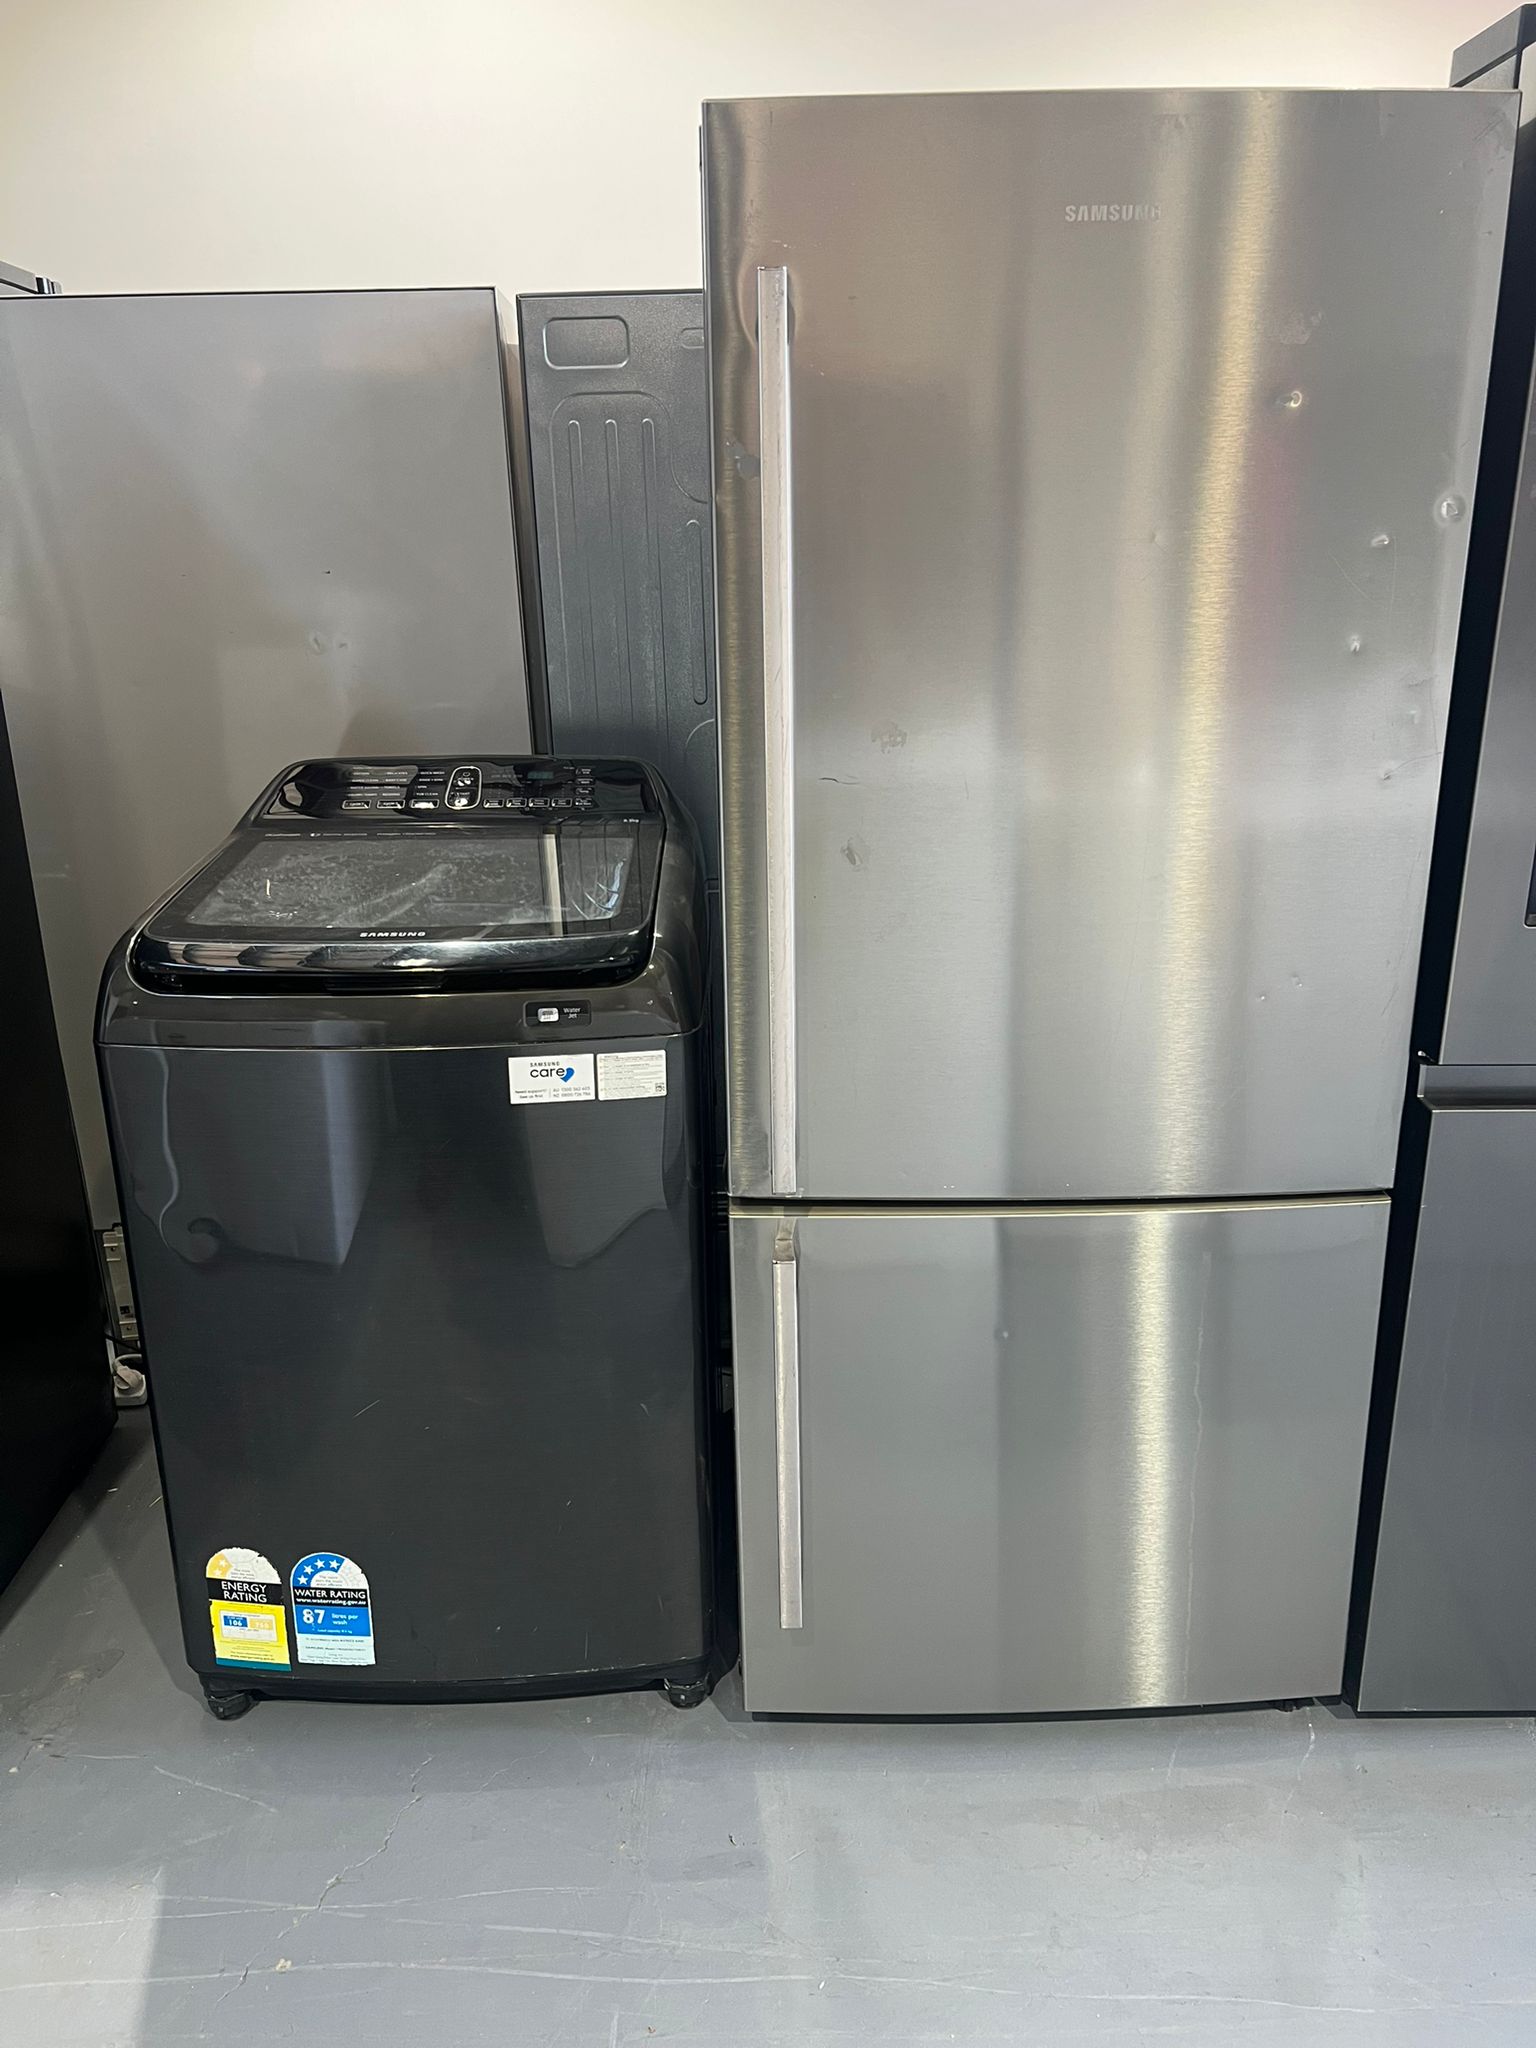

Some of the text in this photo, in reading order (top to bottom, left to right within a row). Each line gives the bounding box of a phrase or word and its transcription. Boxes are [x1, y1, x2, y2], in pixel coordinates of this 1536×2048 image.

[1064, 204, 1162, 223] SAMSUNG
[530, 1067, 565, 1078] care
[221, 1581, 267, 1593] ENERGY
[223, 1590, 268, 1603] RATING
[294, 1589, 366, 1599] WATER RATING
[296, 1598, 367, 1606] www.waterrating.gov.au
[302, 1608, 326, 1624] 87
